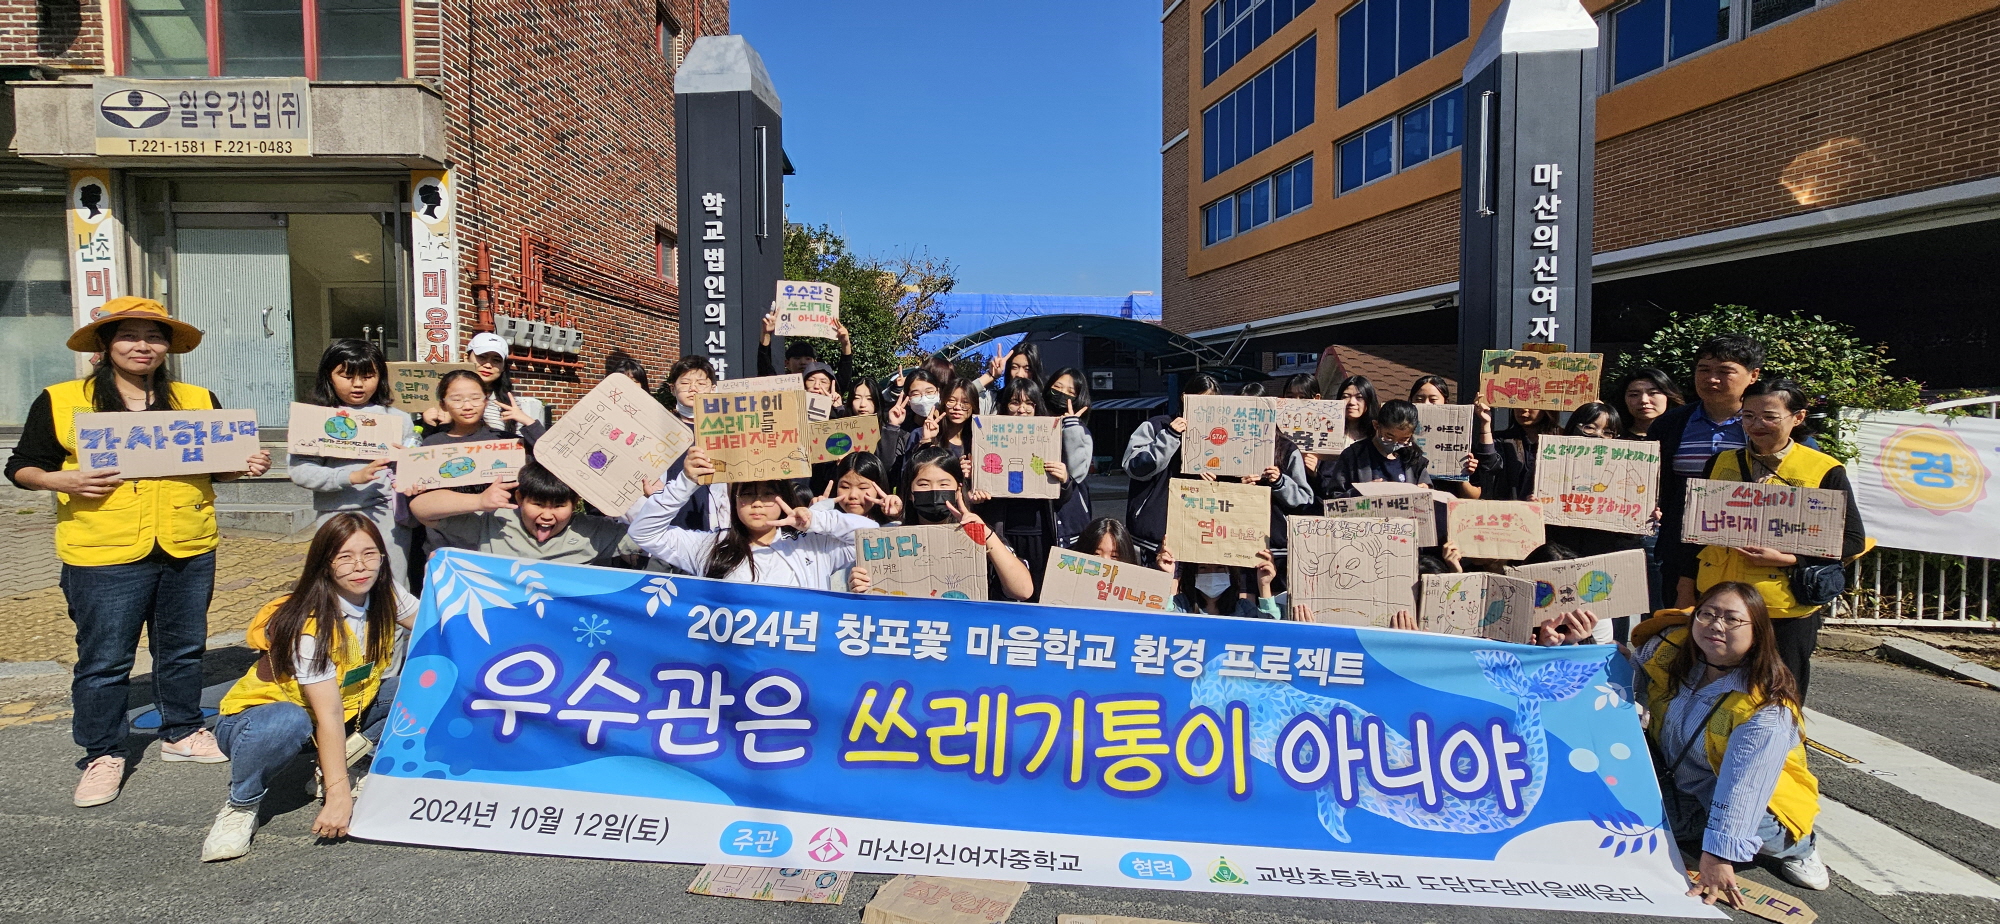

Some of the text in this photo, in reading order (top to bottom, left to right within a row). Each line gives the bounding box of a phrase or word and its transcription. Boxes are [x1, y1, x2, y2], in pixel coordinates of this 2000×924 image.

[178, 90, 301, 129] 일우건업(주)
[128, 139, 293, 154] T.221-1581 F.221-0483
[78, 232, 112, 263] 난초
[1531, 163, 1563, 342] 마산의신여자
[703, 393, 783, 415] 바다에
[700, 411, 777, 436] 쓰레기를
[687, 603, 1366, 686] 2024년 창포꽃 마을학교 환경 프로젝트
[470, 650, 1527, 811] 우수관은 쓰레기통이 아니야
[408, 796, 671, 846] 2024년 10월 12일(토)
[731, 828, 780, 855] 주관
[856, 836, 1084, 873] 마산의신여자중학교
[1131, 857, 1177, 879] 협력
[1255, 865, 1655, 904] 교방초등학교 도담도담마을배움터
